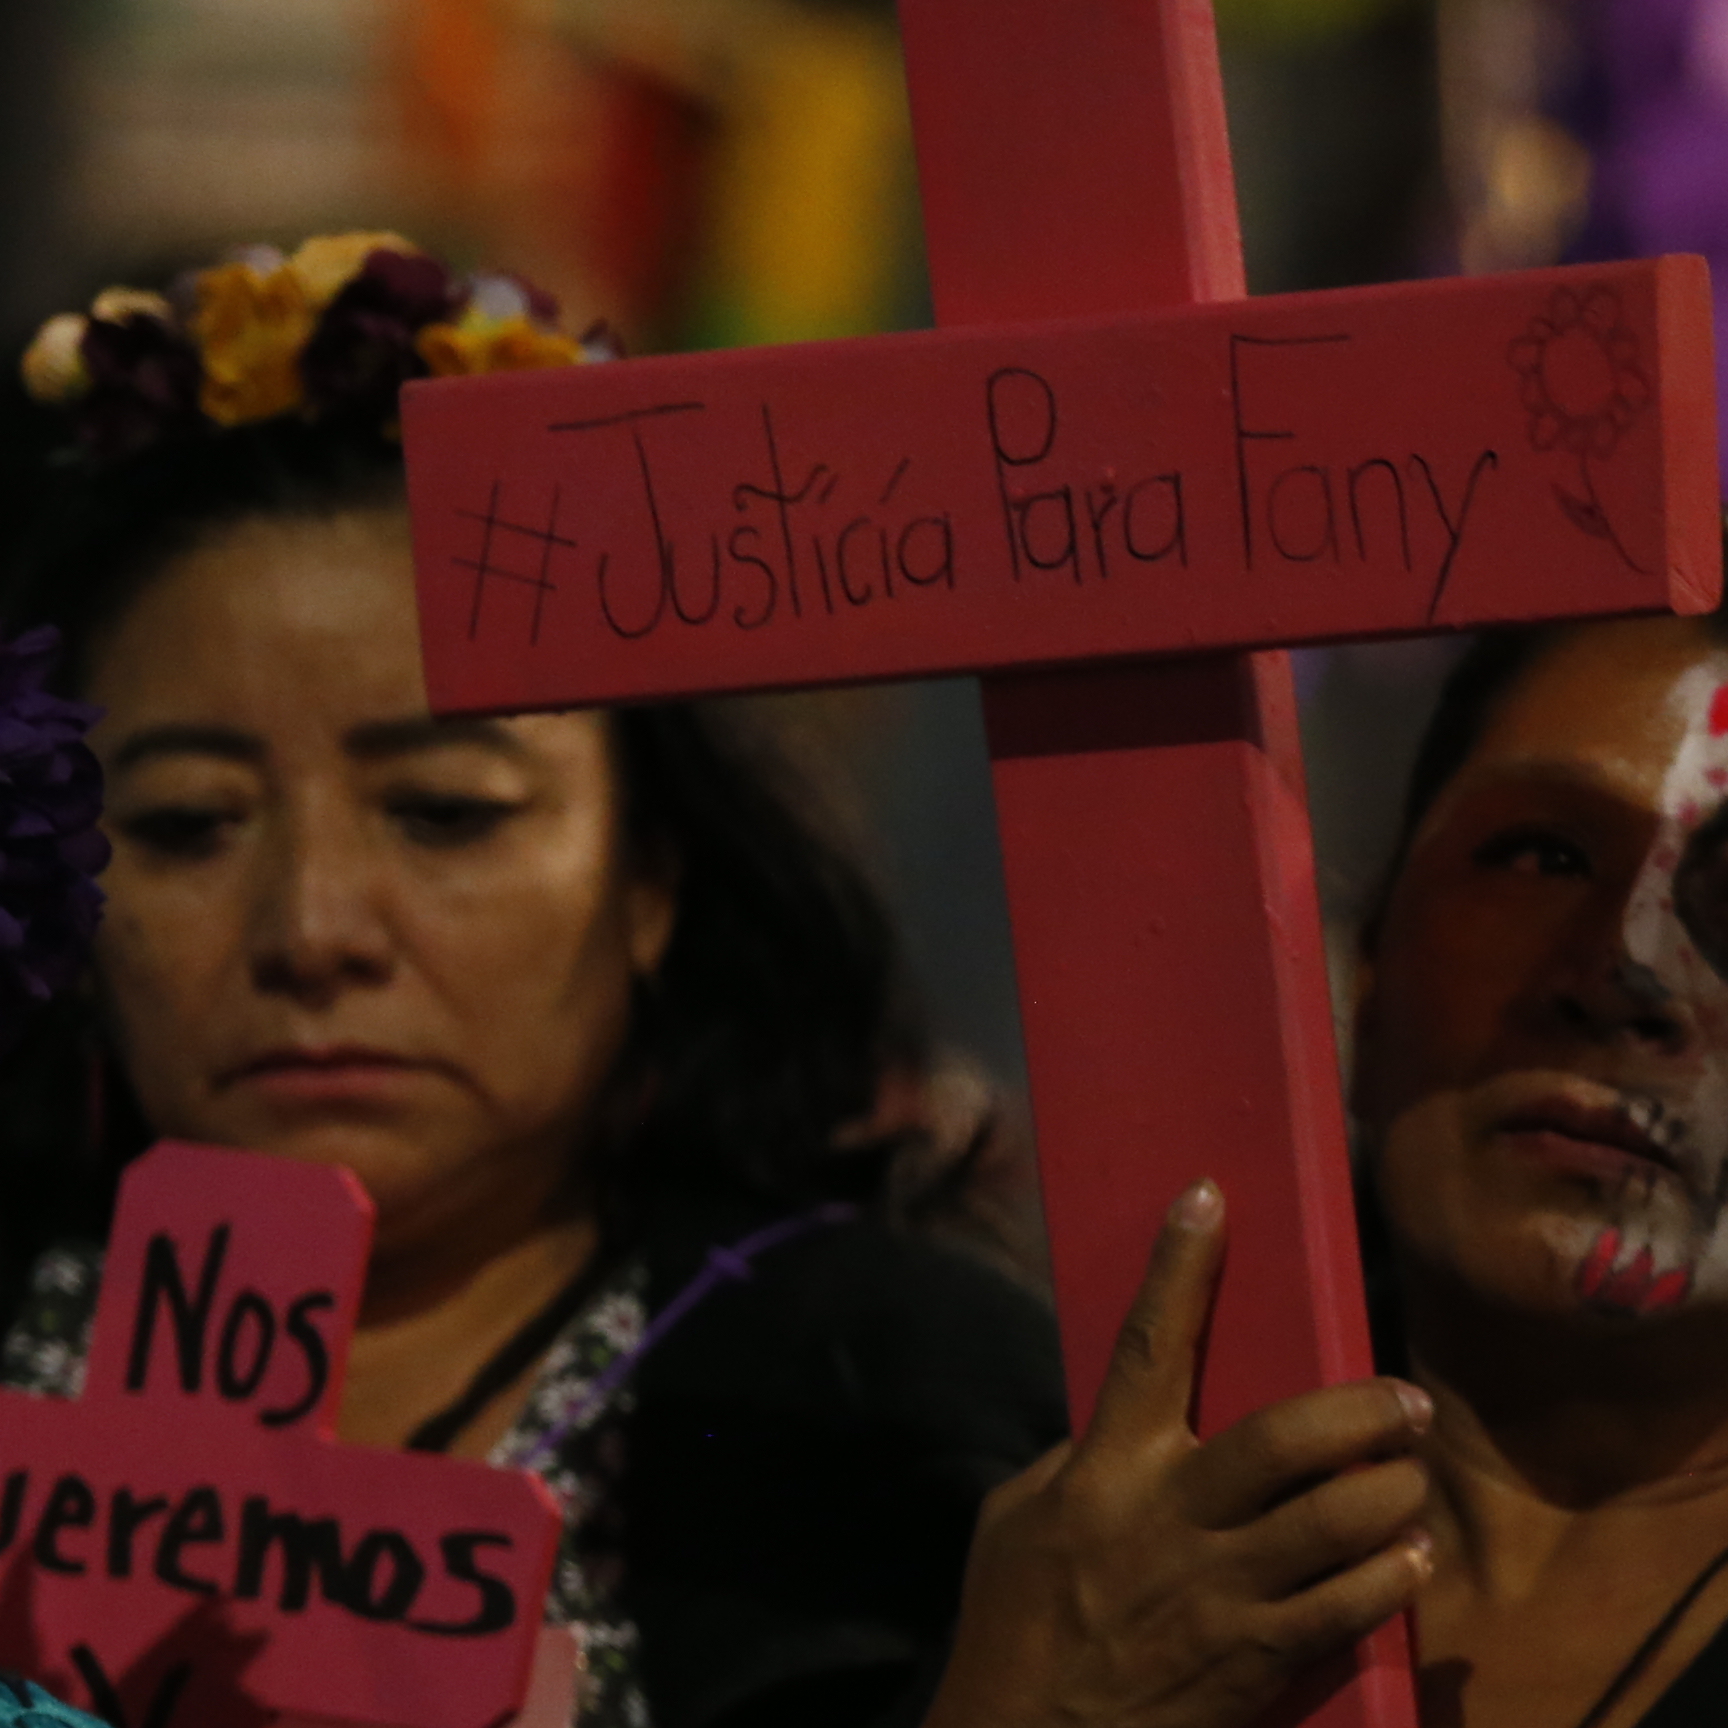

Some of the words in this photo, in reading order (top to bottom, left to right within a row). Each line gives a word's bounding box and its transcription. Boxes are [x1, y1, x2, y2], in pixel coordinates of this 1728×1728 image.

[987, 367, 1187, 585] Para
[1231, 334, 1497, 624] Fany
[126, 1223, 336, 1426] Nos
